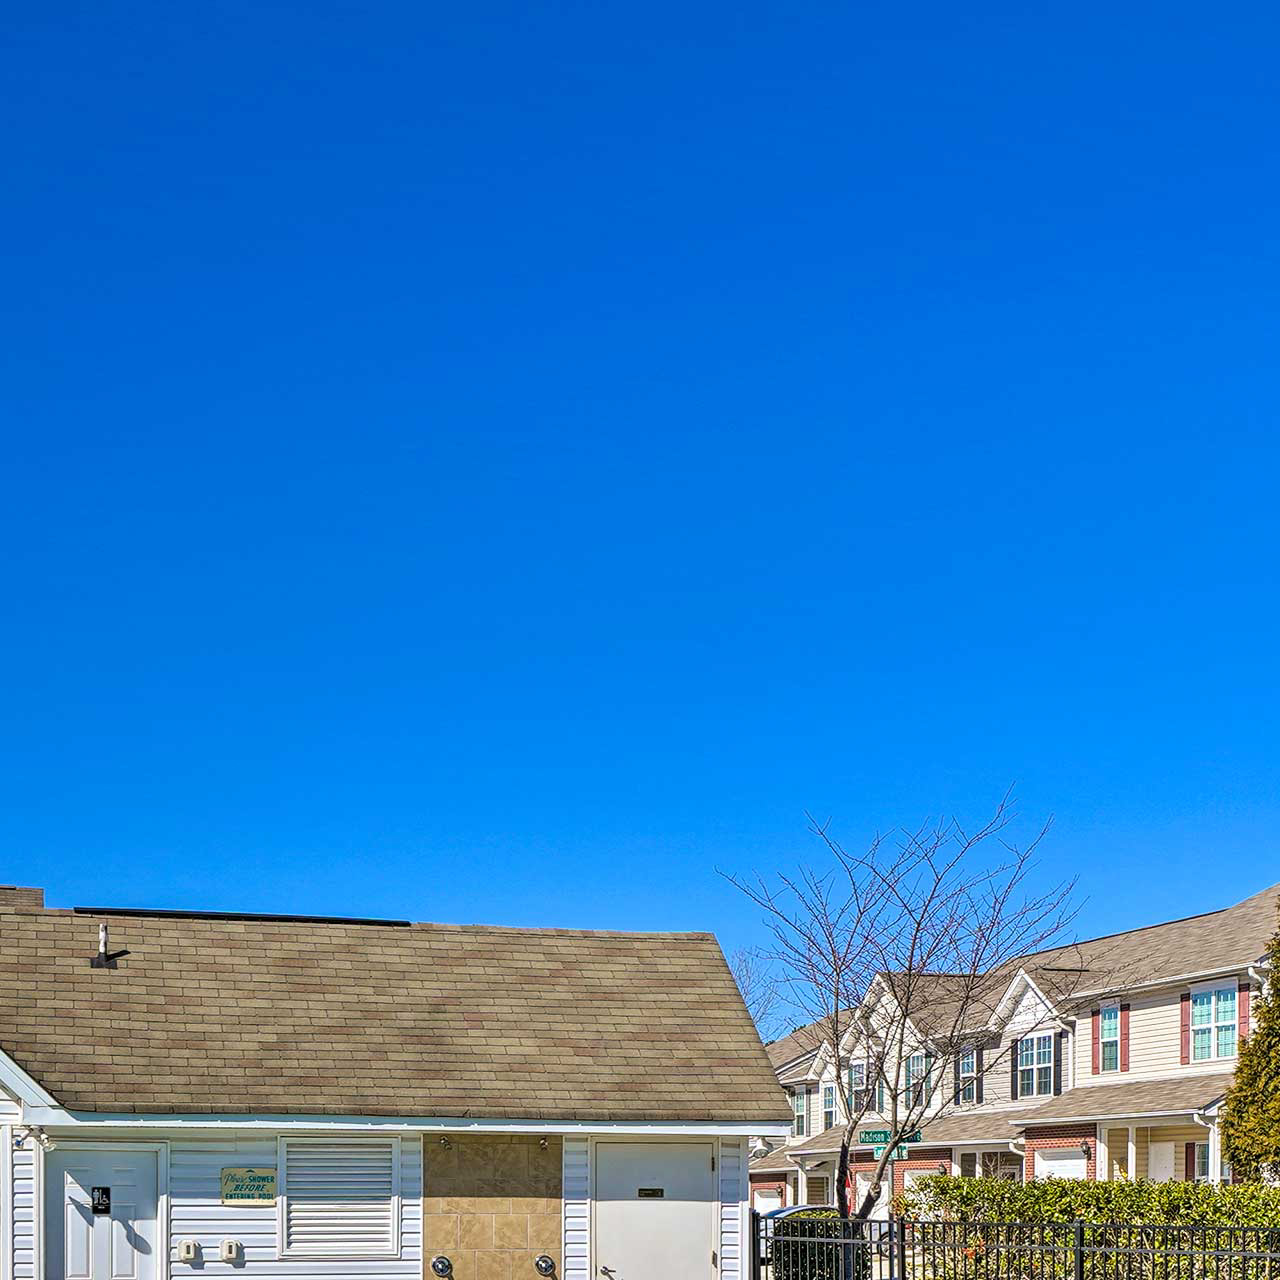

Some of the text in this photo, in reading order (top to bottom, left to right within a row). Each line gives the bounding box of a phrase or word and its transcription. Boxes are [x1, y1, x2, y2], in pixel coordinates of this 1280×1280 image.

[860, 1130, 885, 1142] Madison
[248, 1175, 275, 1183] SHOWER
[233, 1184, 267, 1192] BEFORE
